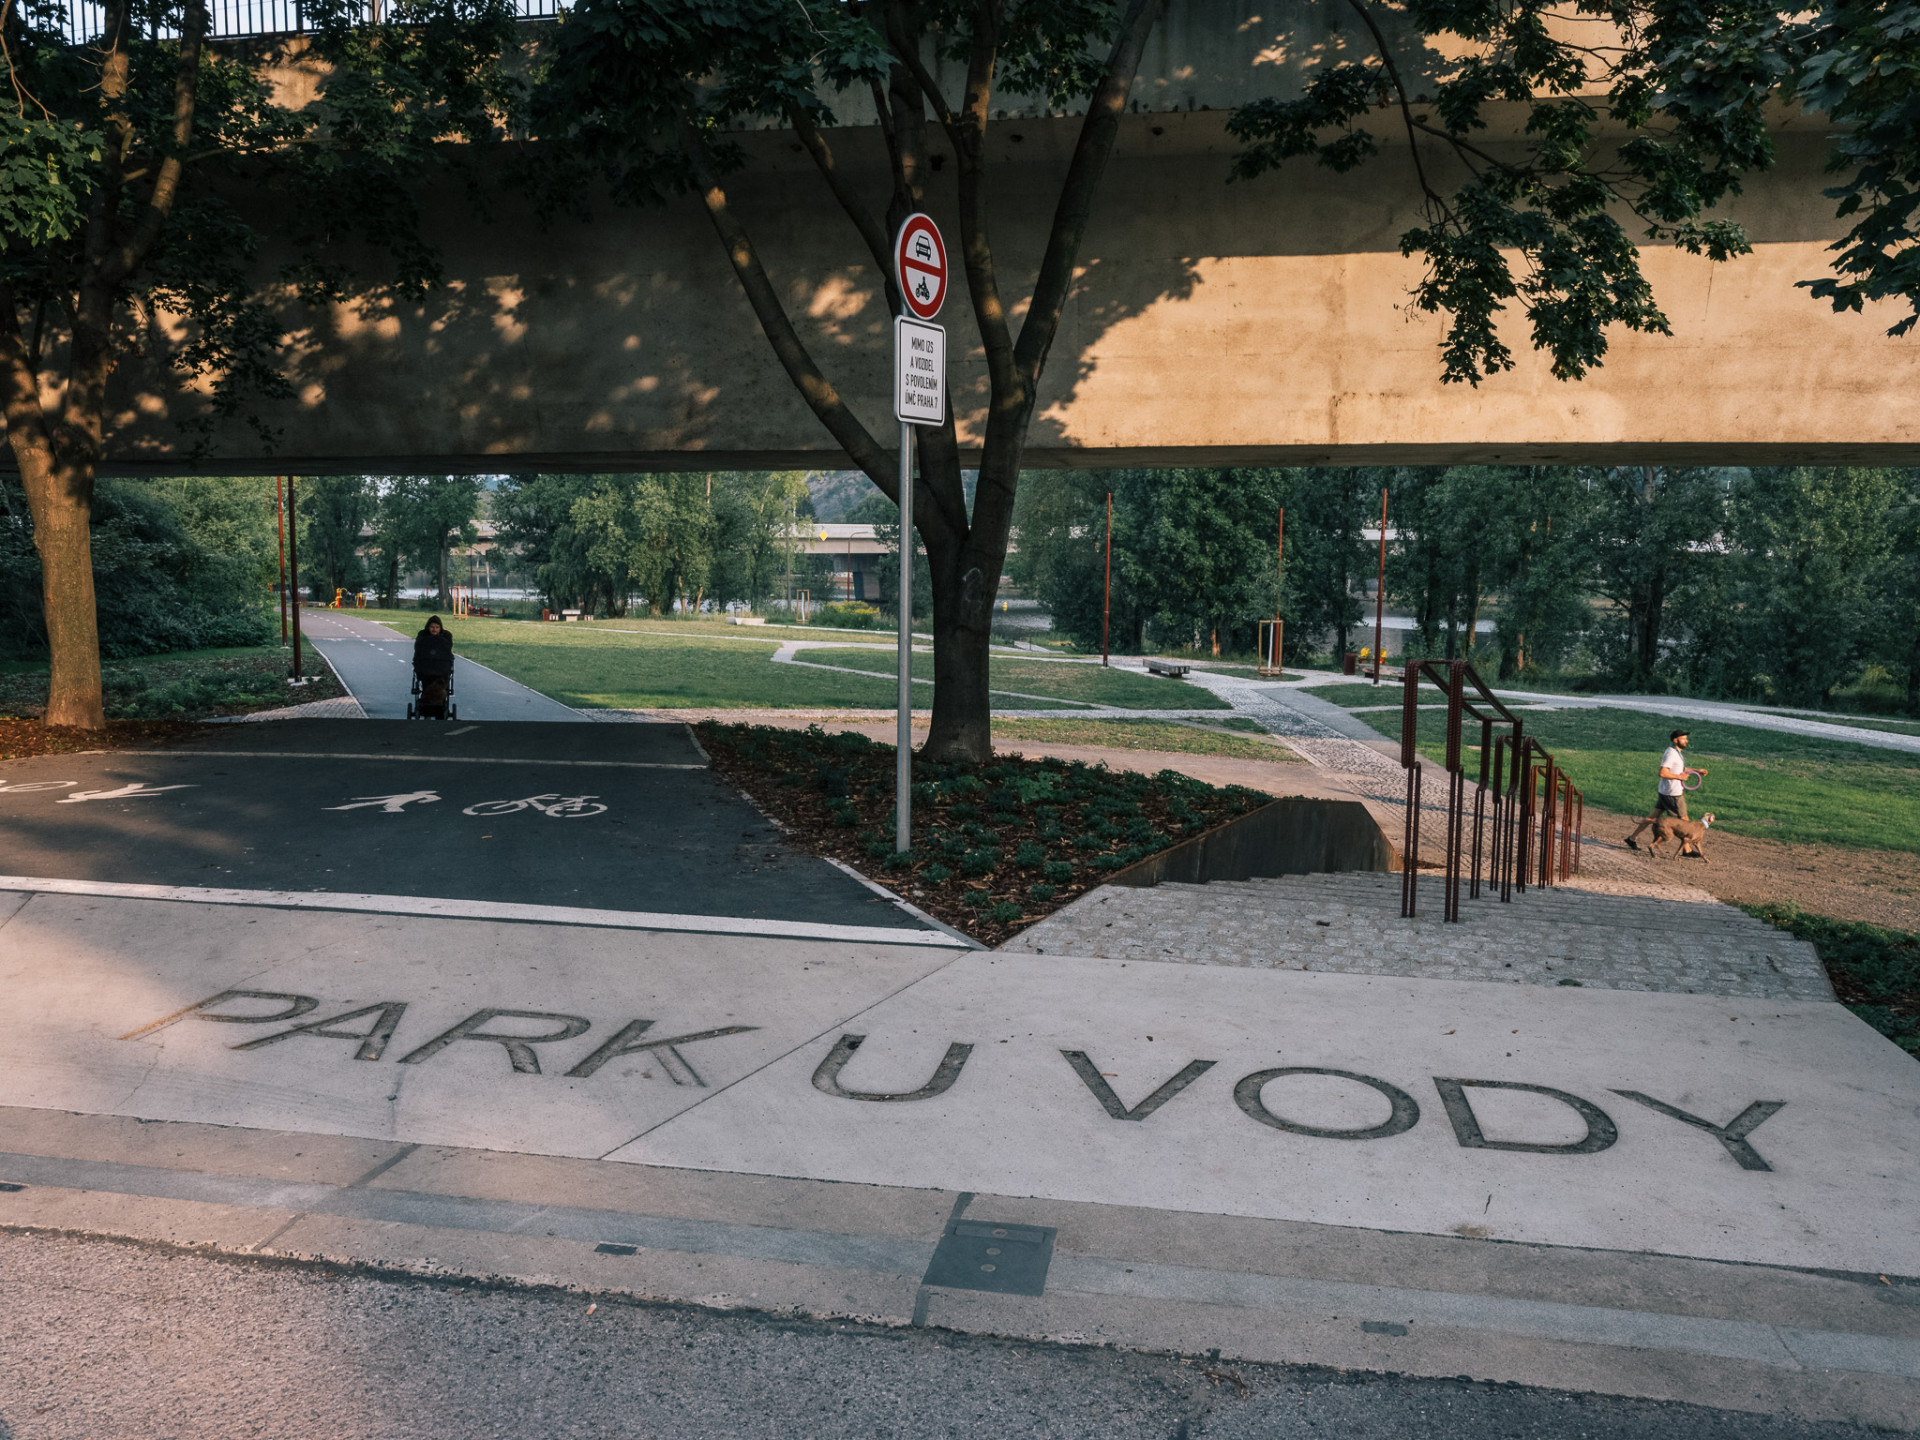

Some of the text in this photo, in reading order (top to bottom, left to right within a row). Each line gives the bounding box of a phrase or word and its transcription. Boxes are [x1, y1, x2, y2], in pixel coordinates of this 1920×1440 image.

[911, 336, 934, 354] MIMO IZS
[910, 356, 934, 372] A VOZIDEL
[905, 374, 938, 391] S POVOLENÍM
[905, 389, 938, 409] ÚMČ PRAHA 7
[117, 989, 1787, 1173] PARK U VODY
